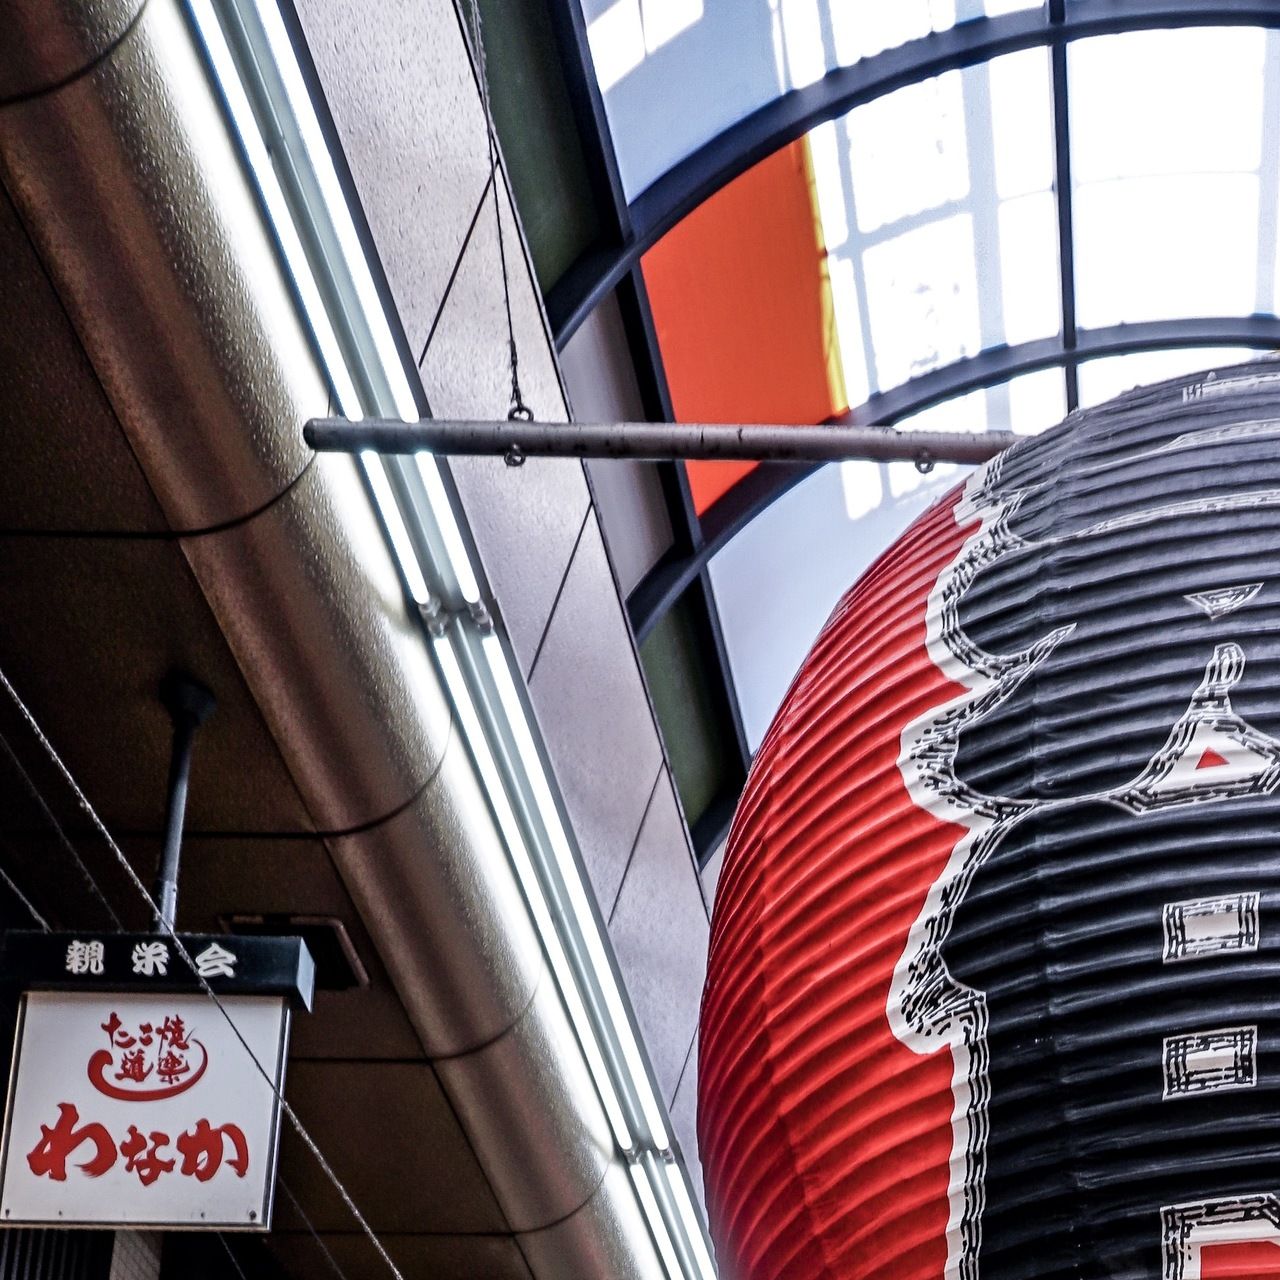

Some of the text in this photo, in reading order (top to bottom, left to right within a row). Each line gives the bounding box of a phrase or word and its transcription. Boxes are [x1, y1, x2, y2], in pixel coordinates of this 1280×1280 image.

[66, 941, 237, 978] 親栄会
[27, 1103, 249, 1186] わなか
